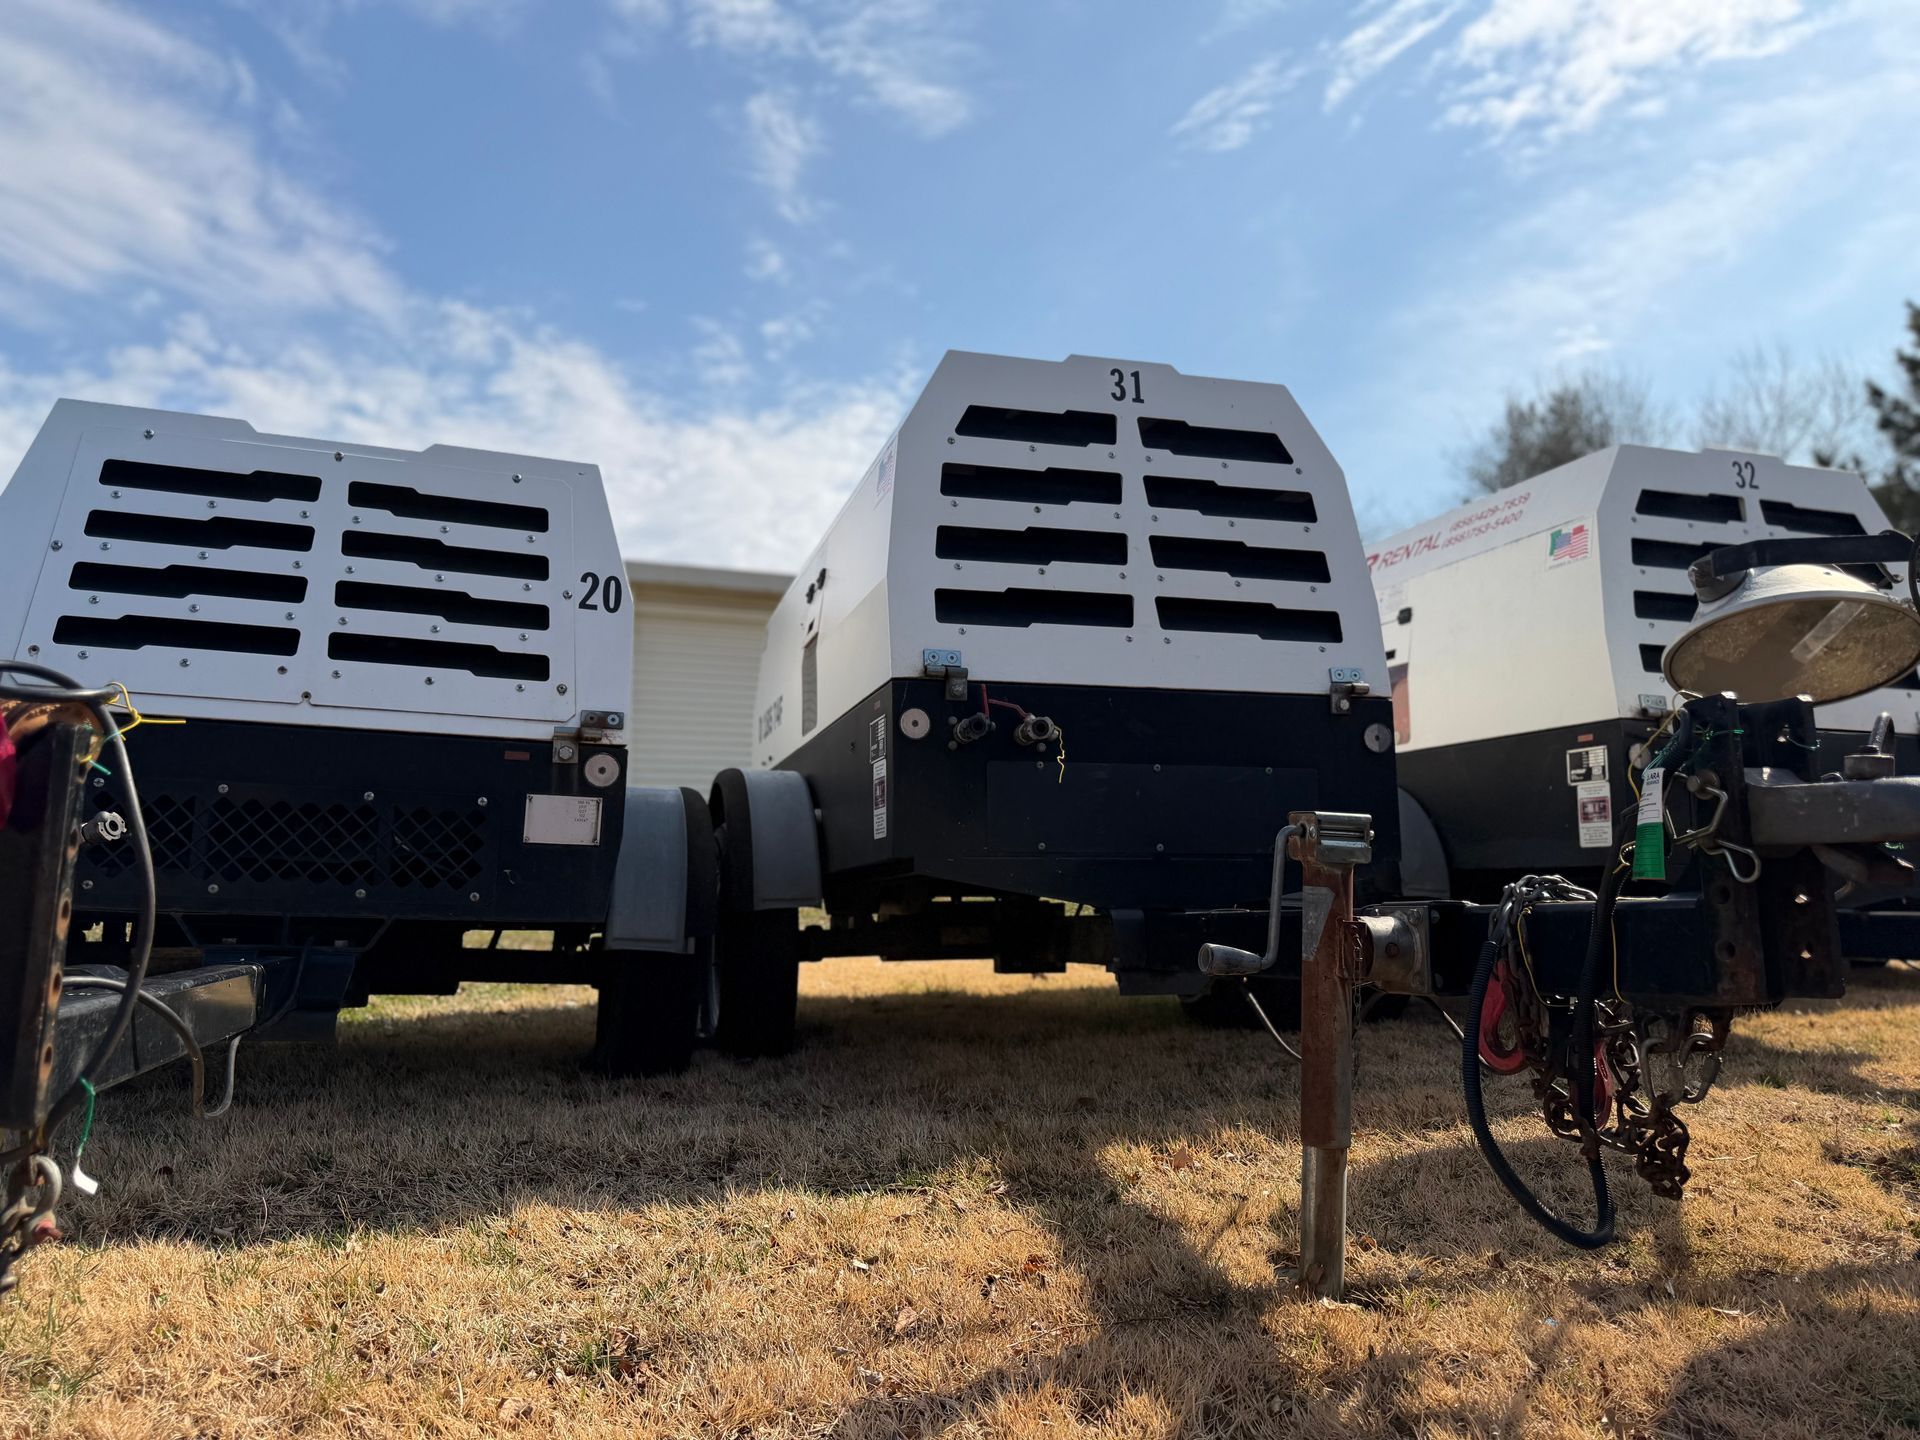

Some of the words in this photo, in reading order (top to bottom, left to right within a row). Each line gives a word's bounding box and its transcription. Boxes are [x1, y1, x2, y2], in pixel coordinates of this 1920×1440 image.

[1110, 368, 1145, 404] 31
[1731, 460, 1760, 490] 32
[1377, 531, 1442, 571] RENTAL
[578, 571, 623, 614] 20
